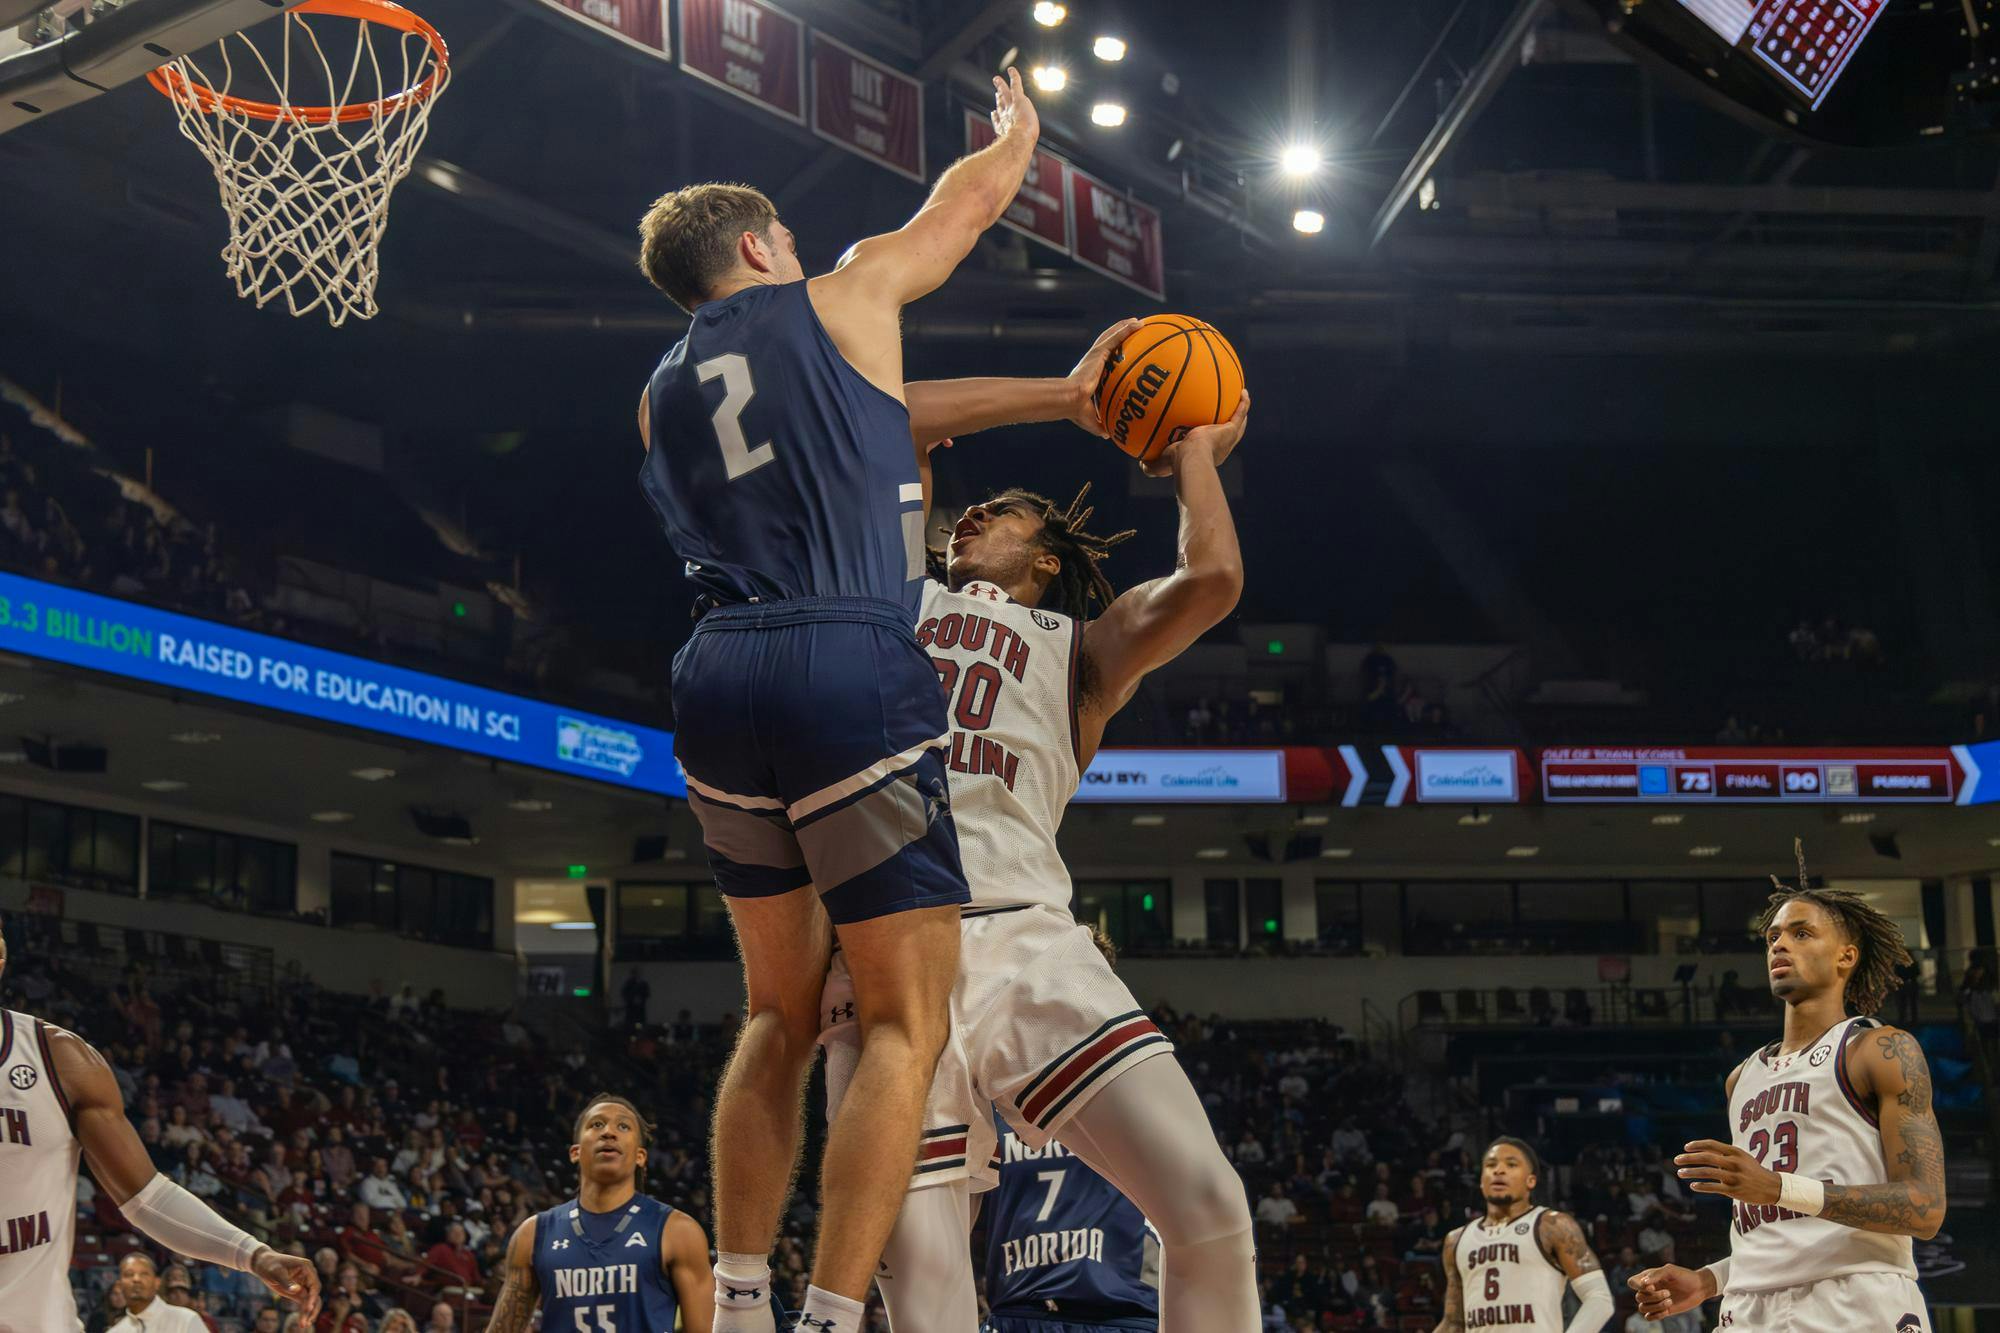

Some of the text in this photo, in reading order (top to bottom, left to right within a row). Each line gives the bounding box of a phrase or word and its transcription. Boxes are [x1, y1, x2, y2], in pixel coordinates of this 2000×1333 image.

[696, 352, 777, 481] 2
[1114, 363, 1171, 446] Wilson
[1031, 610, 1059, 630] SEC
[915, 612, 1031, 684] SOUTH
[46, 607, 152, 657] BILLION
[159, 633, 254, 680] RAISED
[259, 656, 310, 695] FOR
[315, 669, 450, 726] EDUCATION
[455, 702, 480, 732] IN
[945, 731, 1020, 794] LINA
[1160, 773, 1240, 788] Colonial Life
[1427, 774, 1479, 787] Colonial
[1725, 774, 1772, 789] FINAL
[1785, 772, 1818, 791] 90
[1810, 1046, 1831, 1066] SEC
[10, 1067, 37, 1089] SEC
[1739, 1081, 1811, 1133] SOUTH
[1749, 1120, 1799, 1174] 23
[1035, 1169, 1067, 1222] 7
[1001, 1227, 1105, 1277] FLORIDA
[1468, 1243, 1520, 1270] SOUTH
[554, 1263, 638, 1298] NORTH
[1483, 1267, 1500, 1301] 6
[574, 1304, 616, 1333] 55
[1467, 1303, 1536, 1329] CAROLINA
